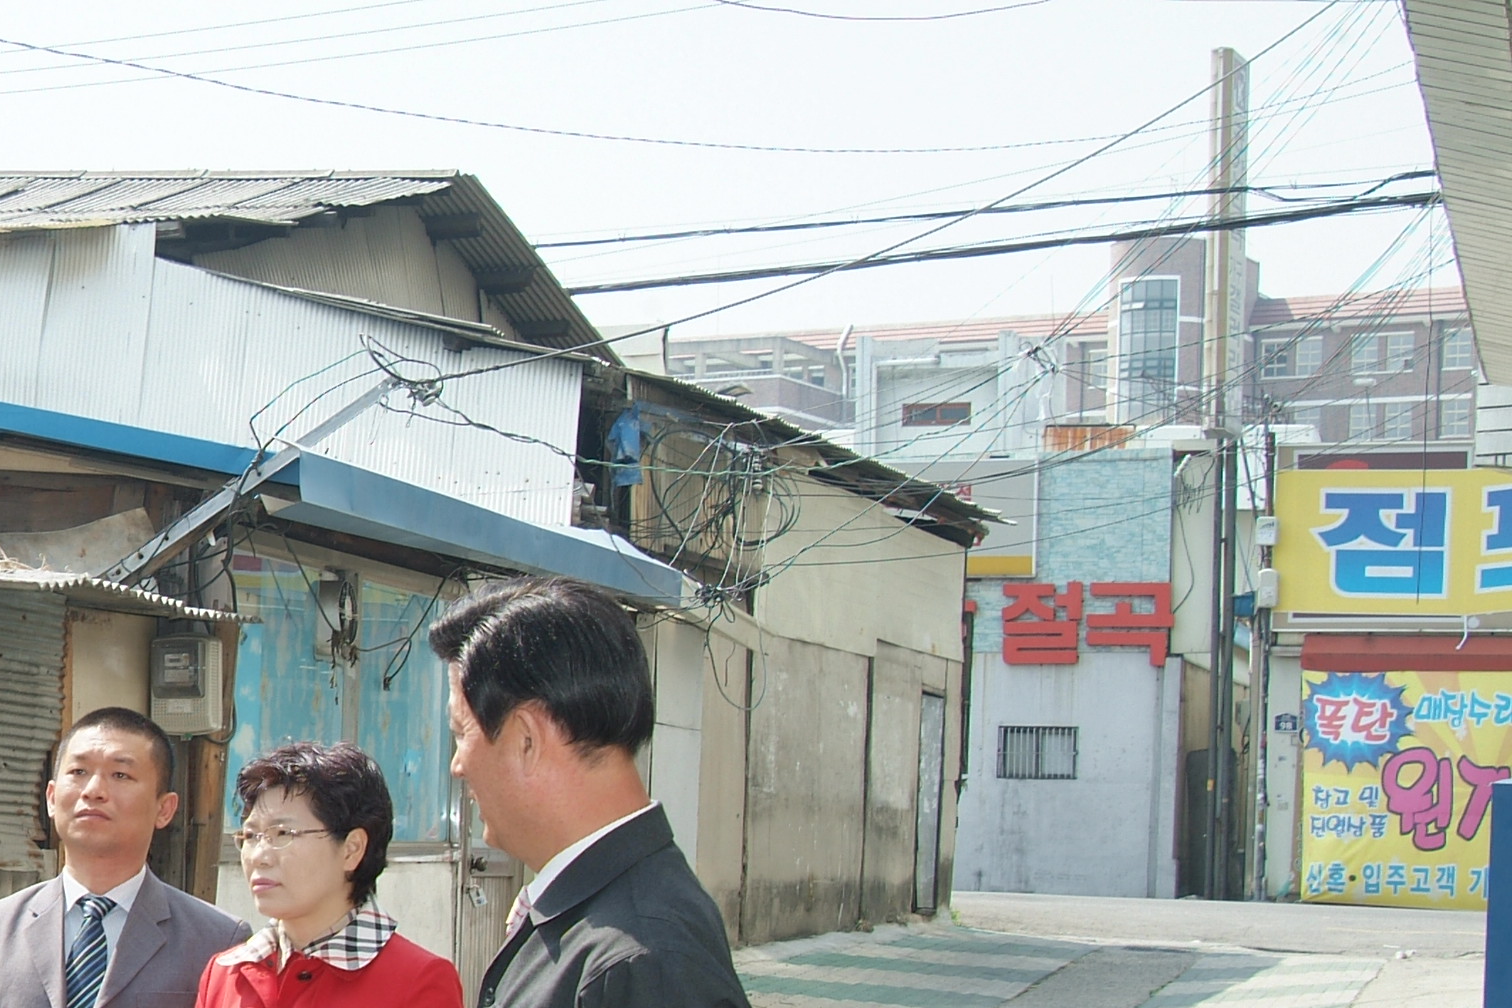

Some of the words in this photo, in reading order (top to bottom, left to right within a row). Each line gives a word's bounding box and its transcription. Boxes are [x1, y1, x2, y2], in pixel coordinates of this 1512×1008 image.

[1002, 581, 1174, 667] 절곡
[1315, 696, 1395, 742] 폭탄
[1312, 785, 1350, 809] 창고
[1310, 813, 1388, 838] 진열상품
